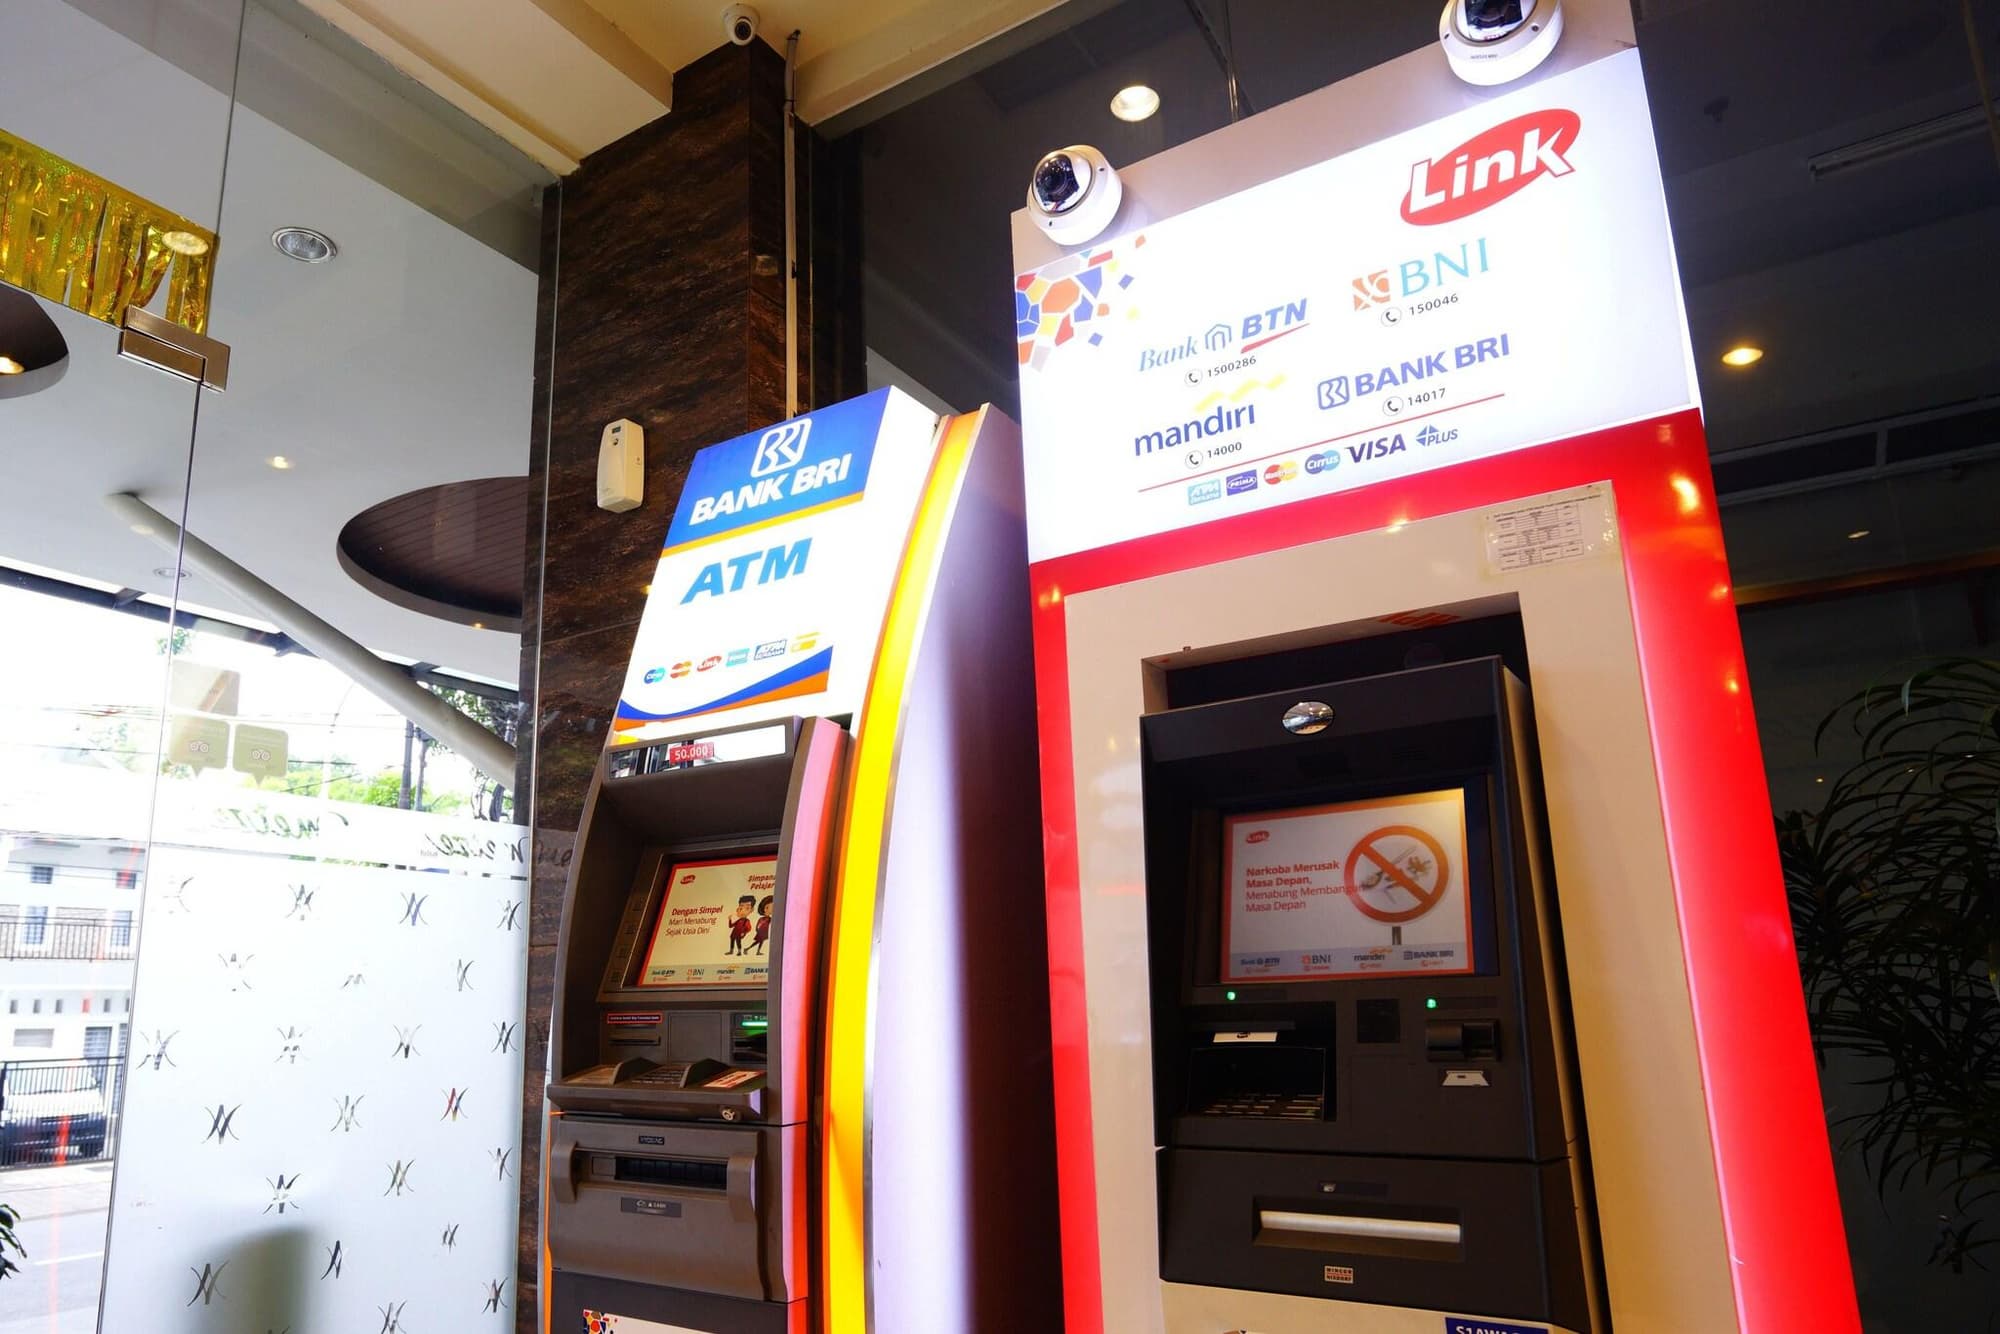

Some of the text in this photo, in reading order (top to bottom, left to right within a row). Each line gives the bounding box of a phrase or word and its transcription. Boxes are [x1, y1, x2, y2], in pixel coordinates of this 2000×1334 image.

[1408, 126, 1577, 215] Link
[1400, 237, 1489, 297] BNI
[1409, 293, 1459, 316] 150046
[1139, 298, 1308, 372] Bank BTN
[1207, 355, 1257, 378] 1500286
[1355, 333, 1510, 397] BANK BRI
[1407, 387, 1447, 406] 14017
[1134, 404, 1256, 457] mandiri
[1427, 428, 1459, 446] PLUS
[1207, 441, 1243, 459] 14000
[1343, 433, 1407, 464] VISA
[1306, 453, 1340, 470] Cirrus
[688, 453, 853, 526] BANK BRI
[679, 537, 814, 606] ATM
[674, 745, 708, 760] 50.000
[1246, 860, 1340, 877] Narkoba Merusak
[1246, 879, 1273, 888] Masa
[1246, 888, 1298, 900] Menabung
[671, 904, 724, 917] Dengan Simpel
[1246, 901, 1306, 912] Masa Depan
[1312, 955, 1332, 964] BNI
